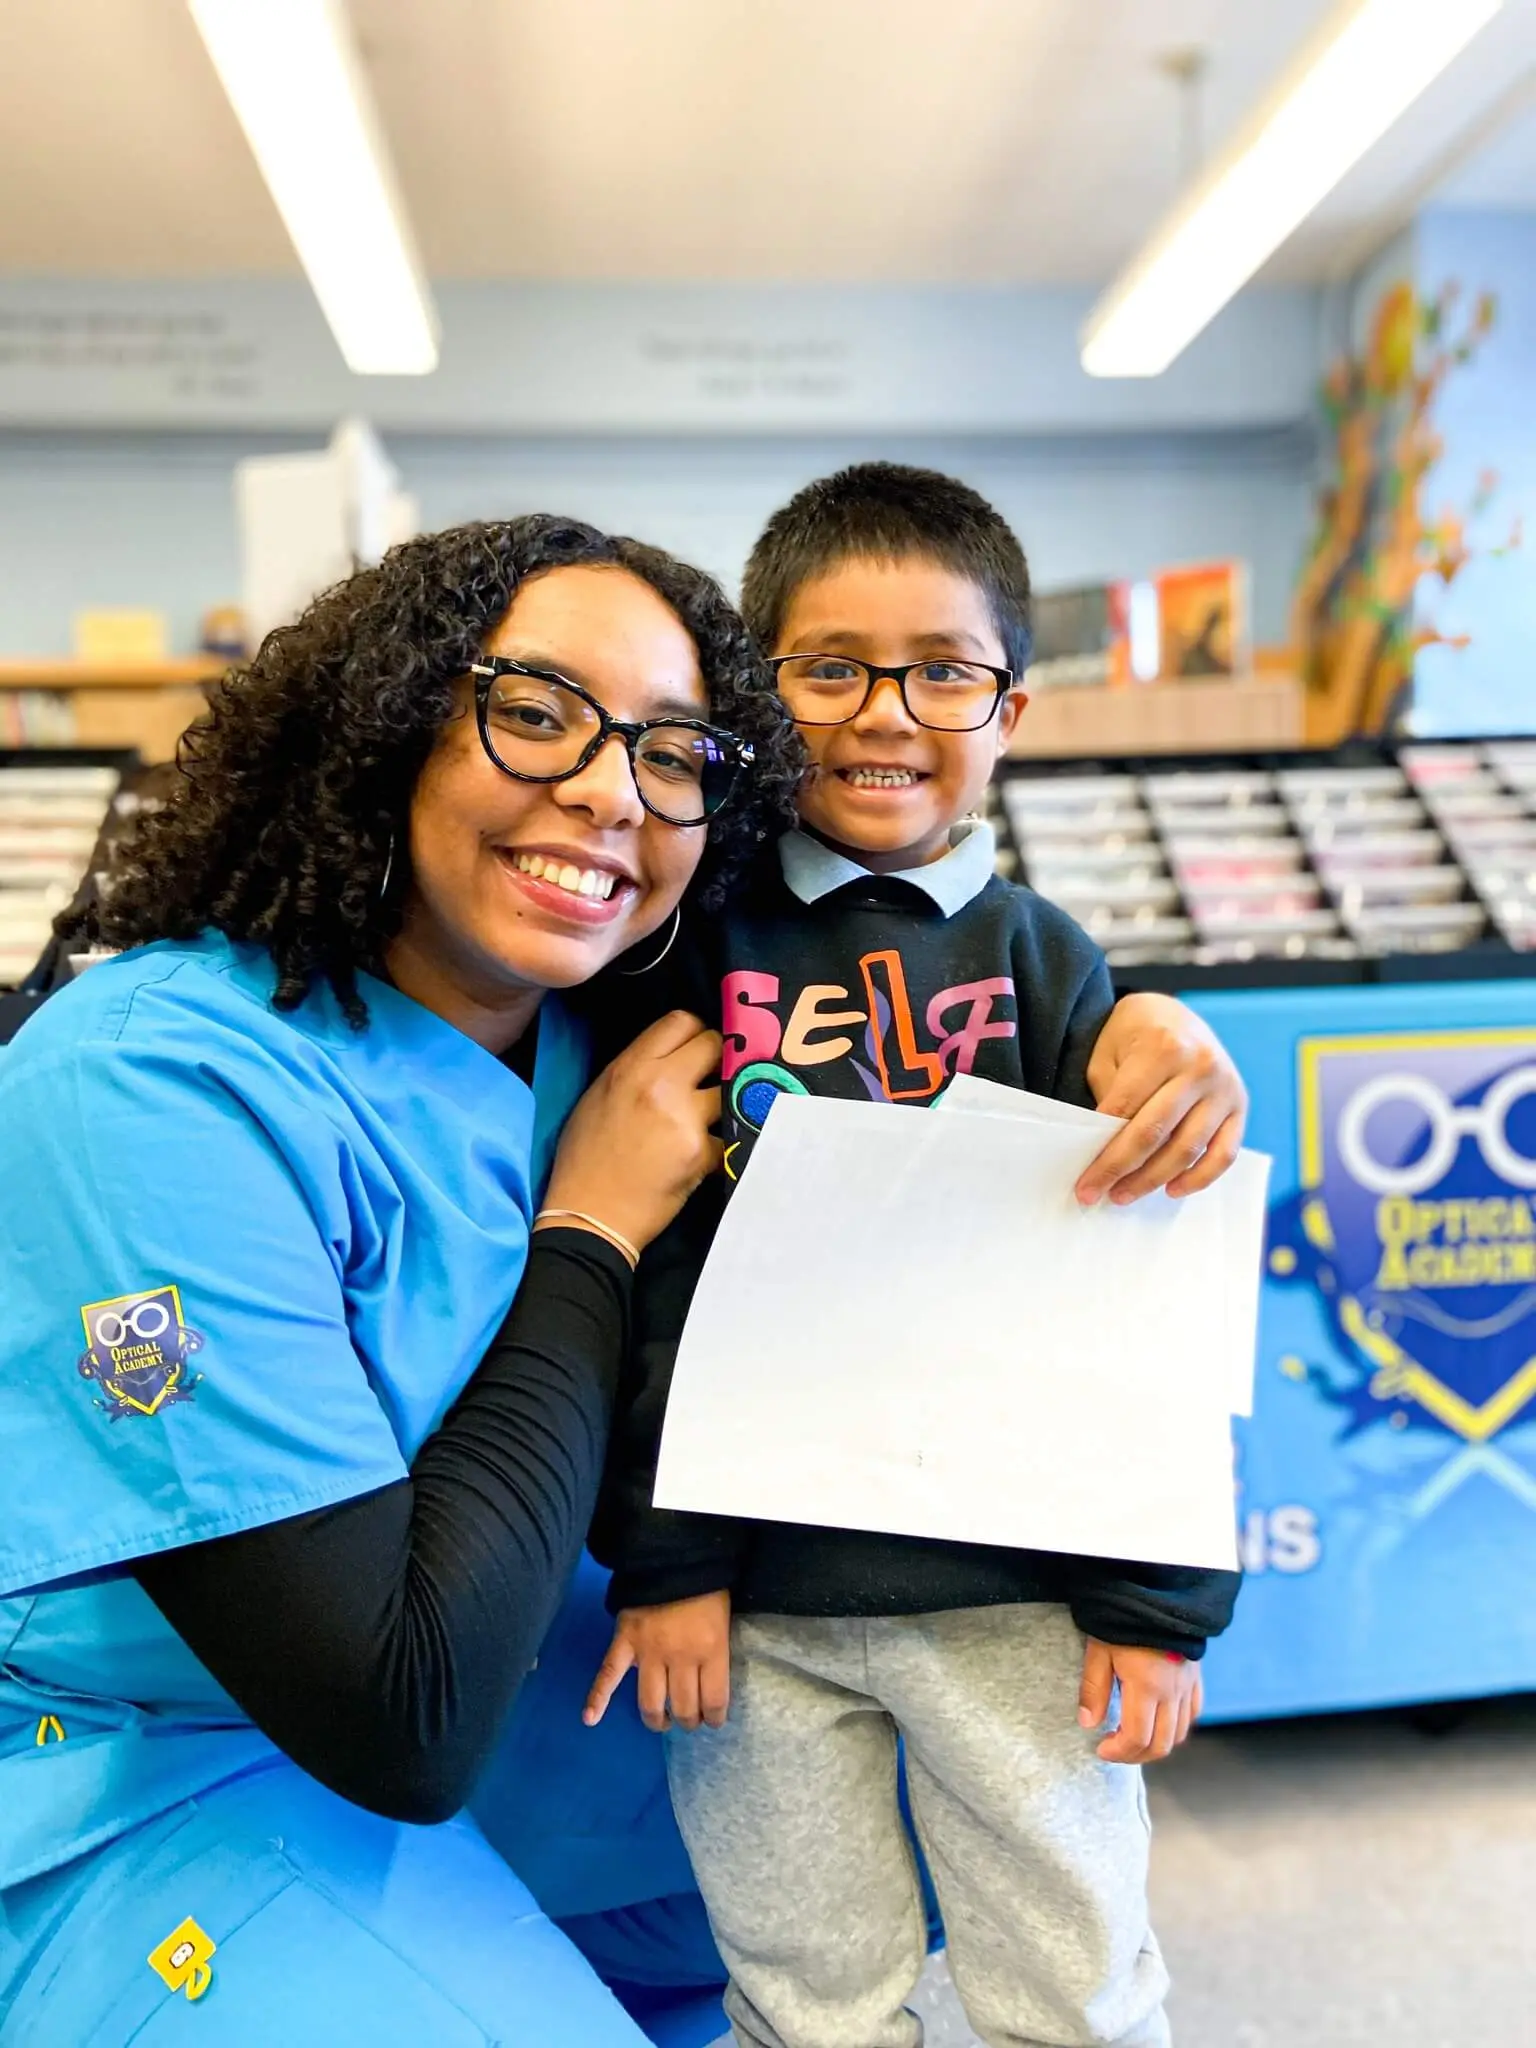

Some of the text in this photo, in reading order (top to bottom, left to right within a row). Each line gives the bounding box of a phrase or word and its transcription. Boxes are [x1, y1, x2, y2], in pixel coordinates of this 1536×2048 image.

[721, 949, 1016, 1100] SELF
[1376, 1194, 1536, 1243] OPTICA
[111, 1341, 161, 1361] OPTICAL
[114, 1352, 163, 1374] ACADEMY
